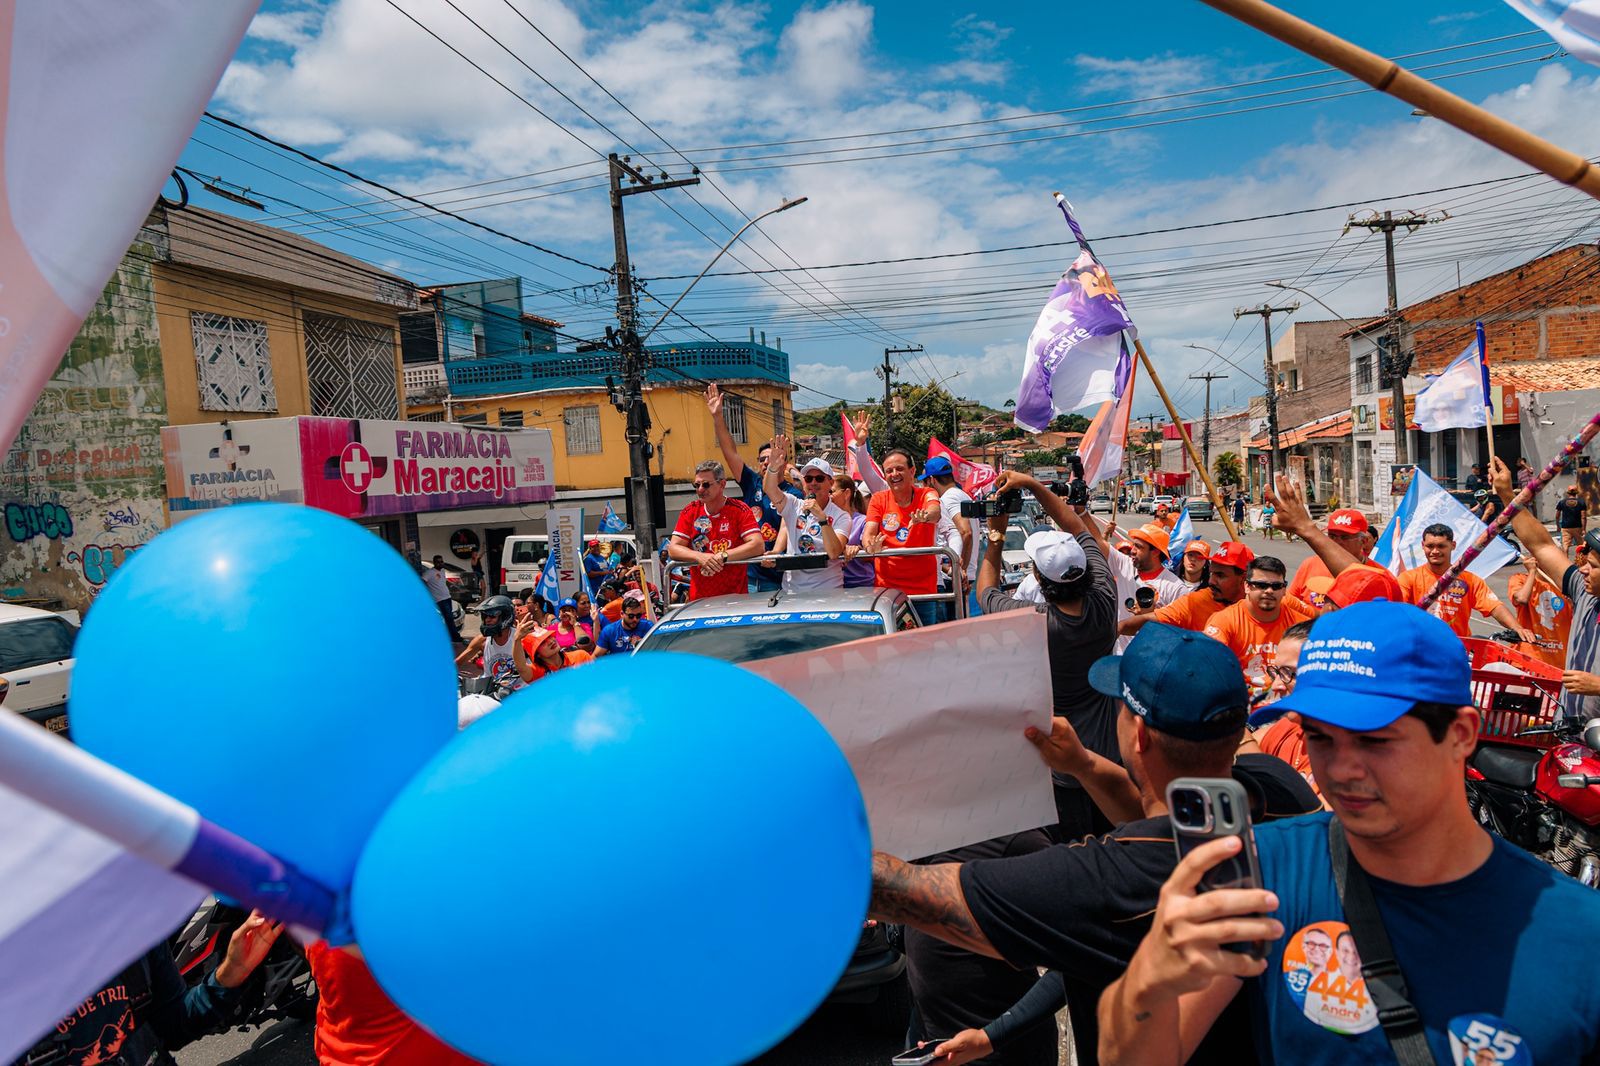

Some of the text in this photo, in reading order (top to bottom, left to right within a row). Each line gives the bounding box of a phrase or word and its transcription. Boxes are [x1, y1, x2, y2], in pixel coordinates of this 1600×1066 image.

[396, 428, 512, 459] FARMÁCIA
[190, 467, 275, 486] FARMÁCIA
[394, 458, 516, 497] Maracaju
[189, 480, 279, 501] Maracaju
[560, 515, 576, 582] Maracaju
[1327, 637, 1376, 652] sufoque,
[1332, 651, 1351, 660] em
[1328, 660, 1376, 678] política.
[1287, 971, 1309, 987] 55
[96, 984, 148, 1006] TRIL
[1308, 971, 1369, 1009] 444
[1321, 1003, 1361, 1019] André
[1462, 1020, 1522, 1061] 55
